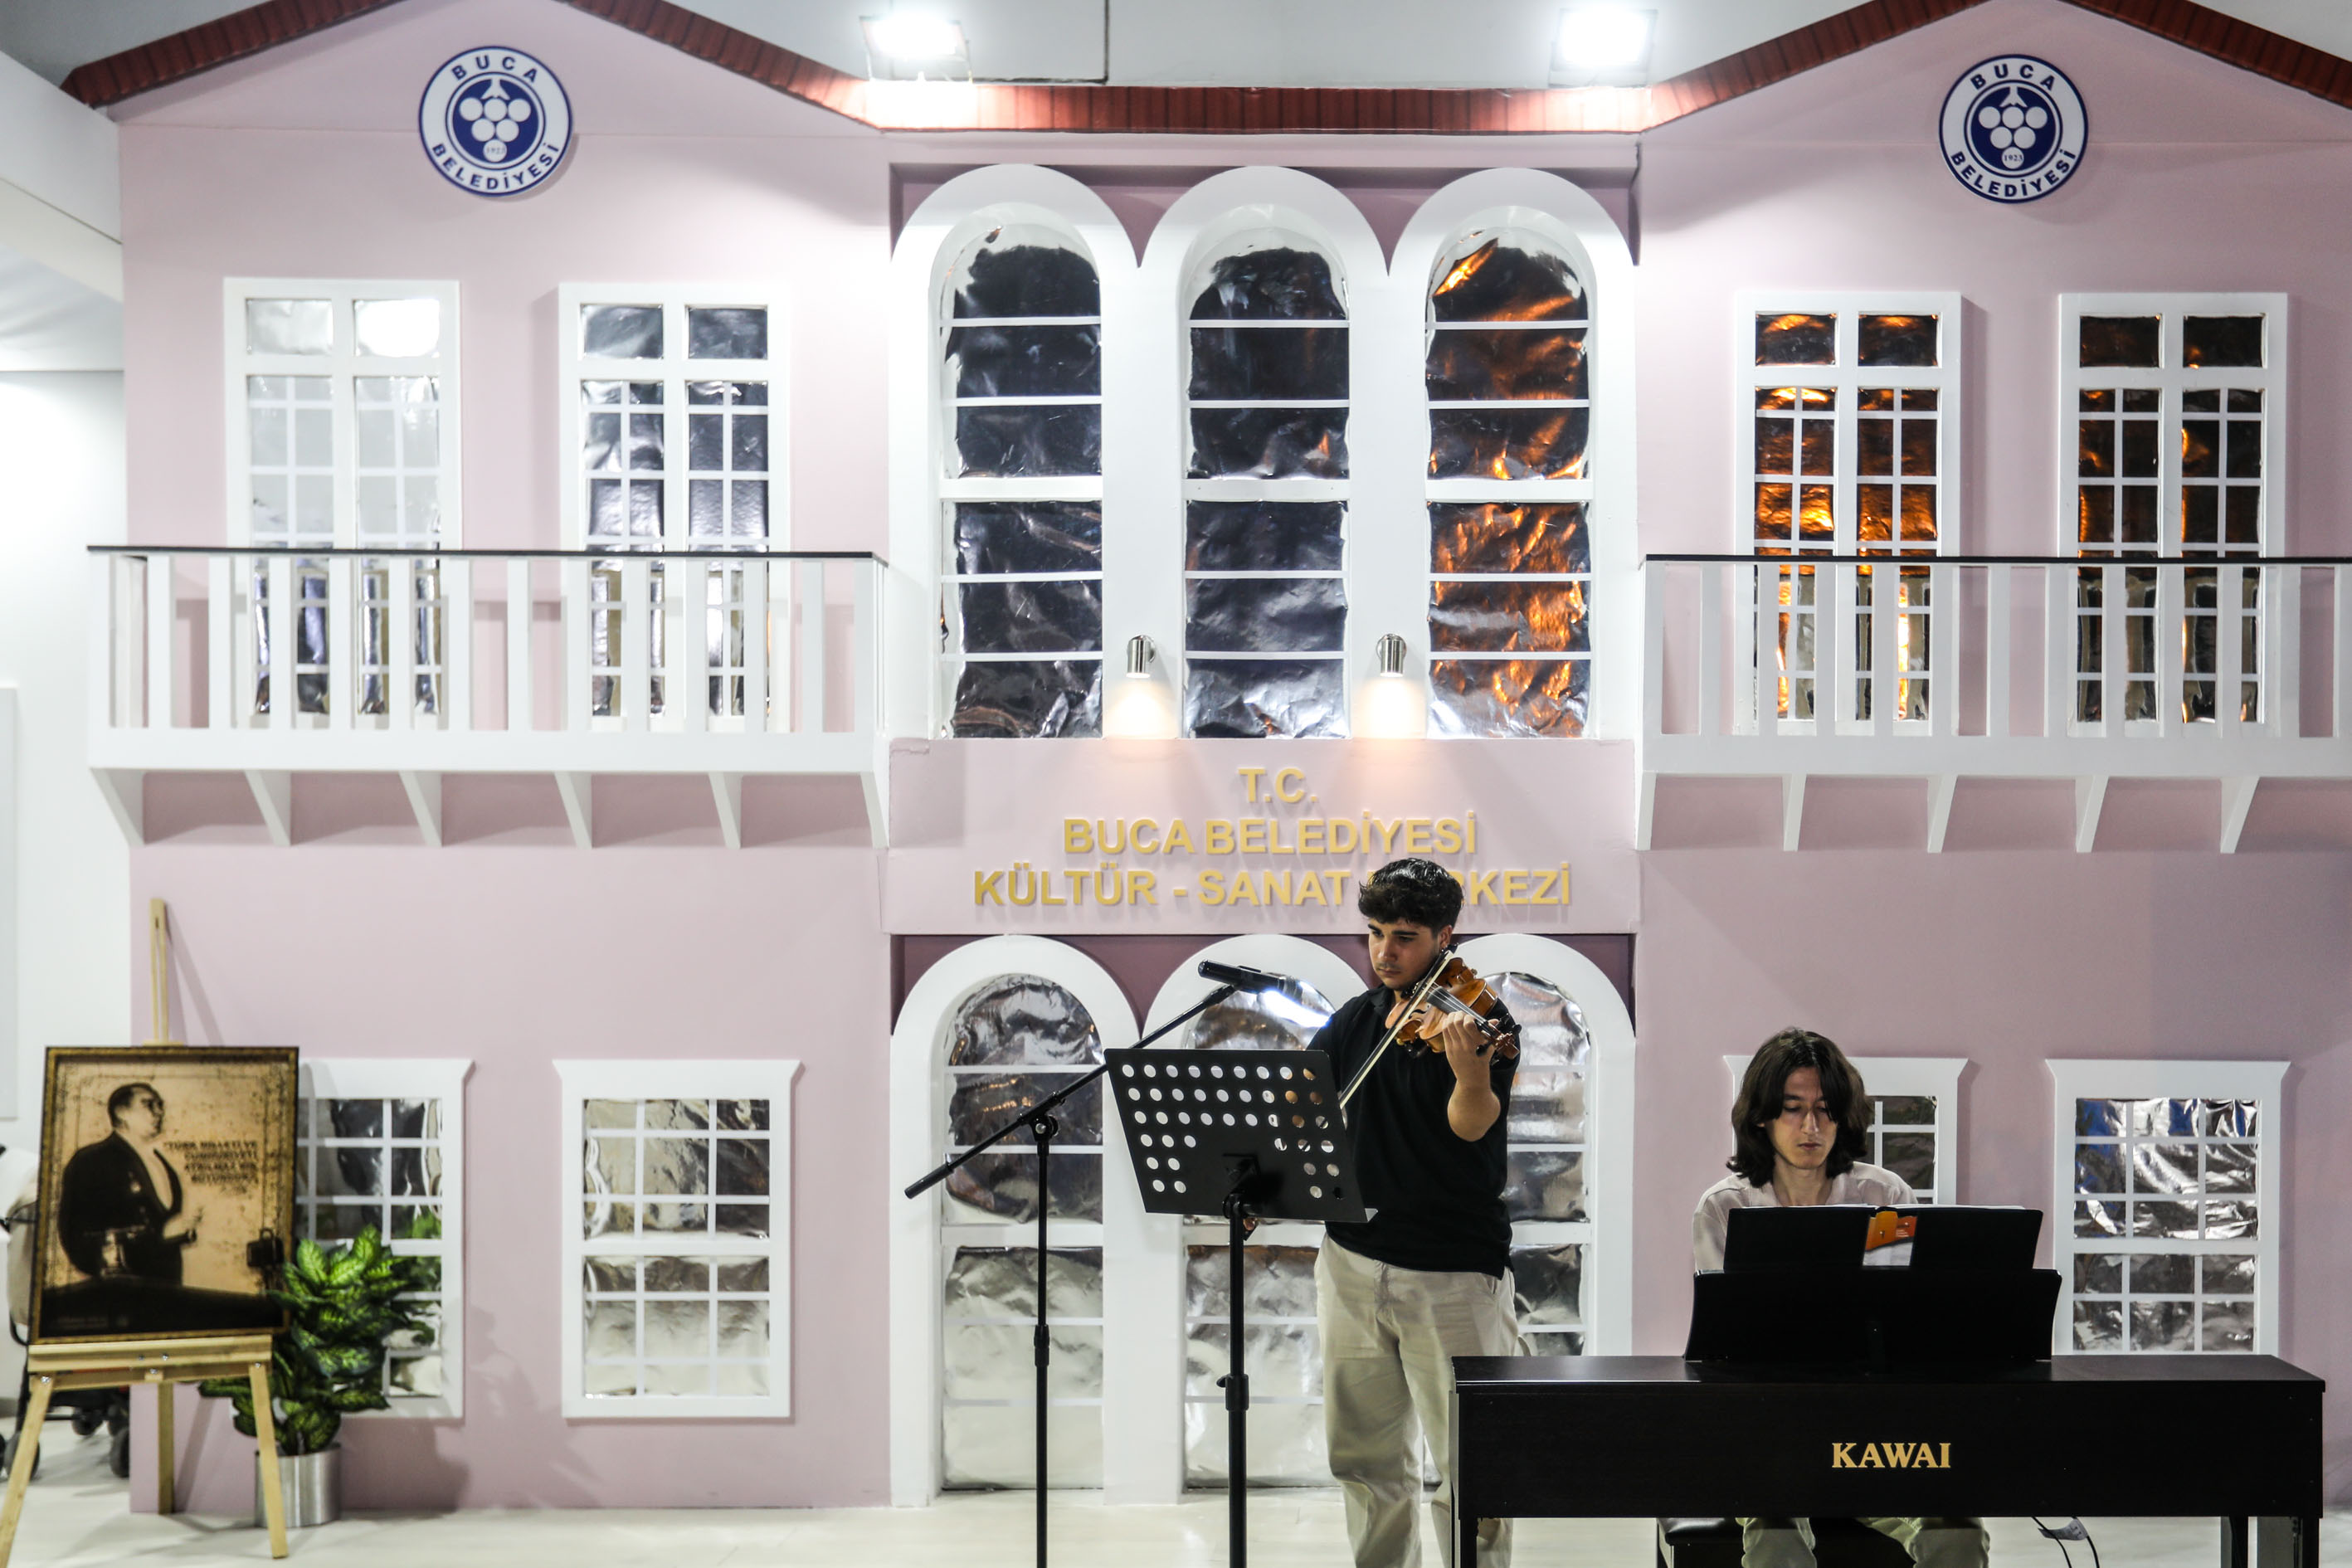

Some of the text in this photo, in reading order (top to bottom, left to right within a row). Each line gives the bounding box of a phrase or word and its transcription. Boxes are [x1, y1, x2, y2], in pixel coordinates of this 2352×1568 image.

[450, 55, 537, 83] BUCA
[1970, 64, 2055, 91] BUCA
[432, 143, 559, 190] BELEDİYESİ
[1951, 149, 2077, 197] BELEDİYESİ
[1238, 767, 1317, 803] T.C.
[1064, 810, 1476, 855] BUCA BELEDİYESİ
[974, 862, 1157, 906] KÜLTÜR
[1197, 869, 1351, 906] SANAT
[1831, 1442, 1951, 1468] KAWAI
